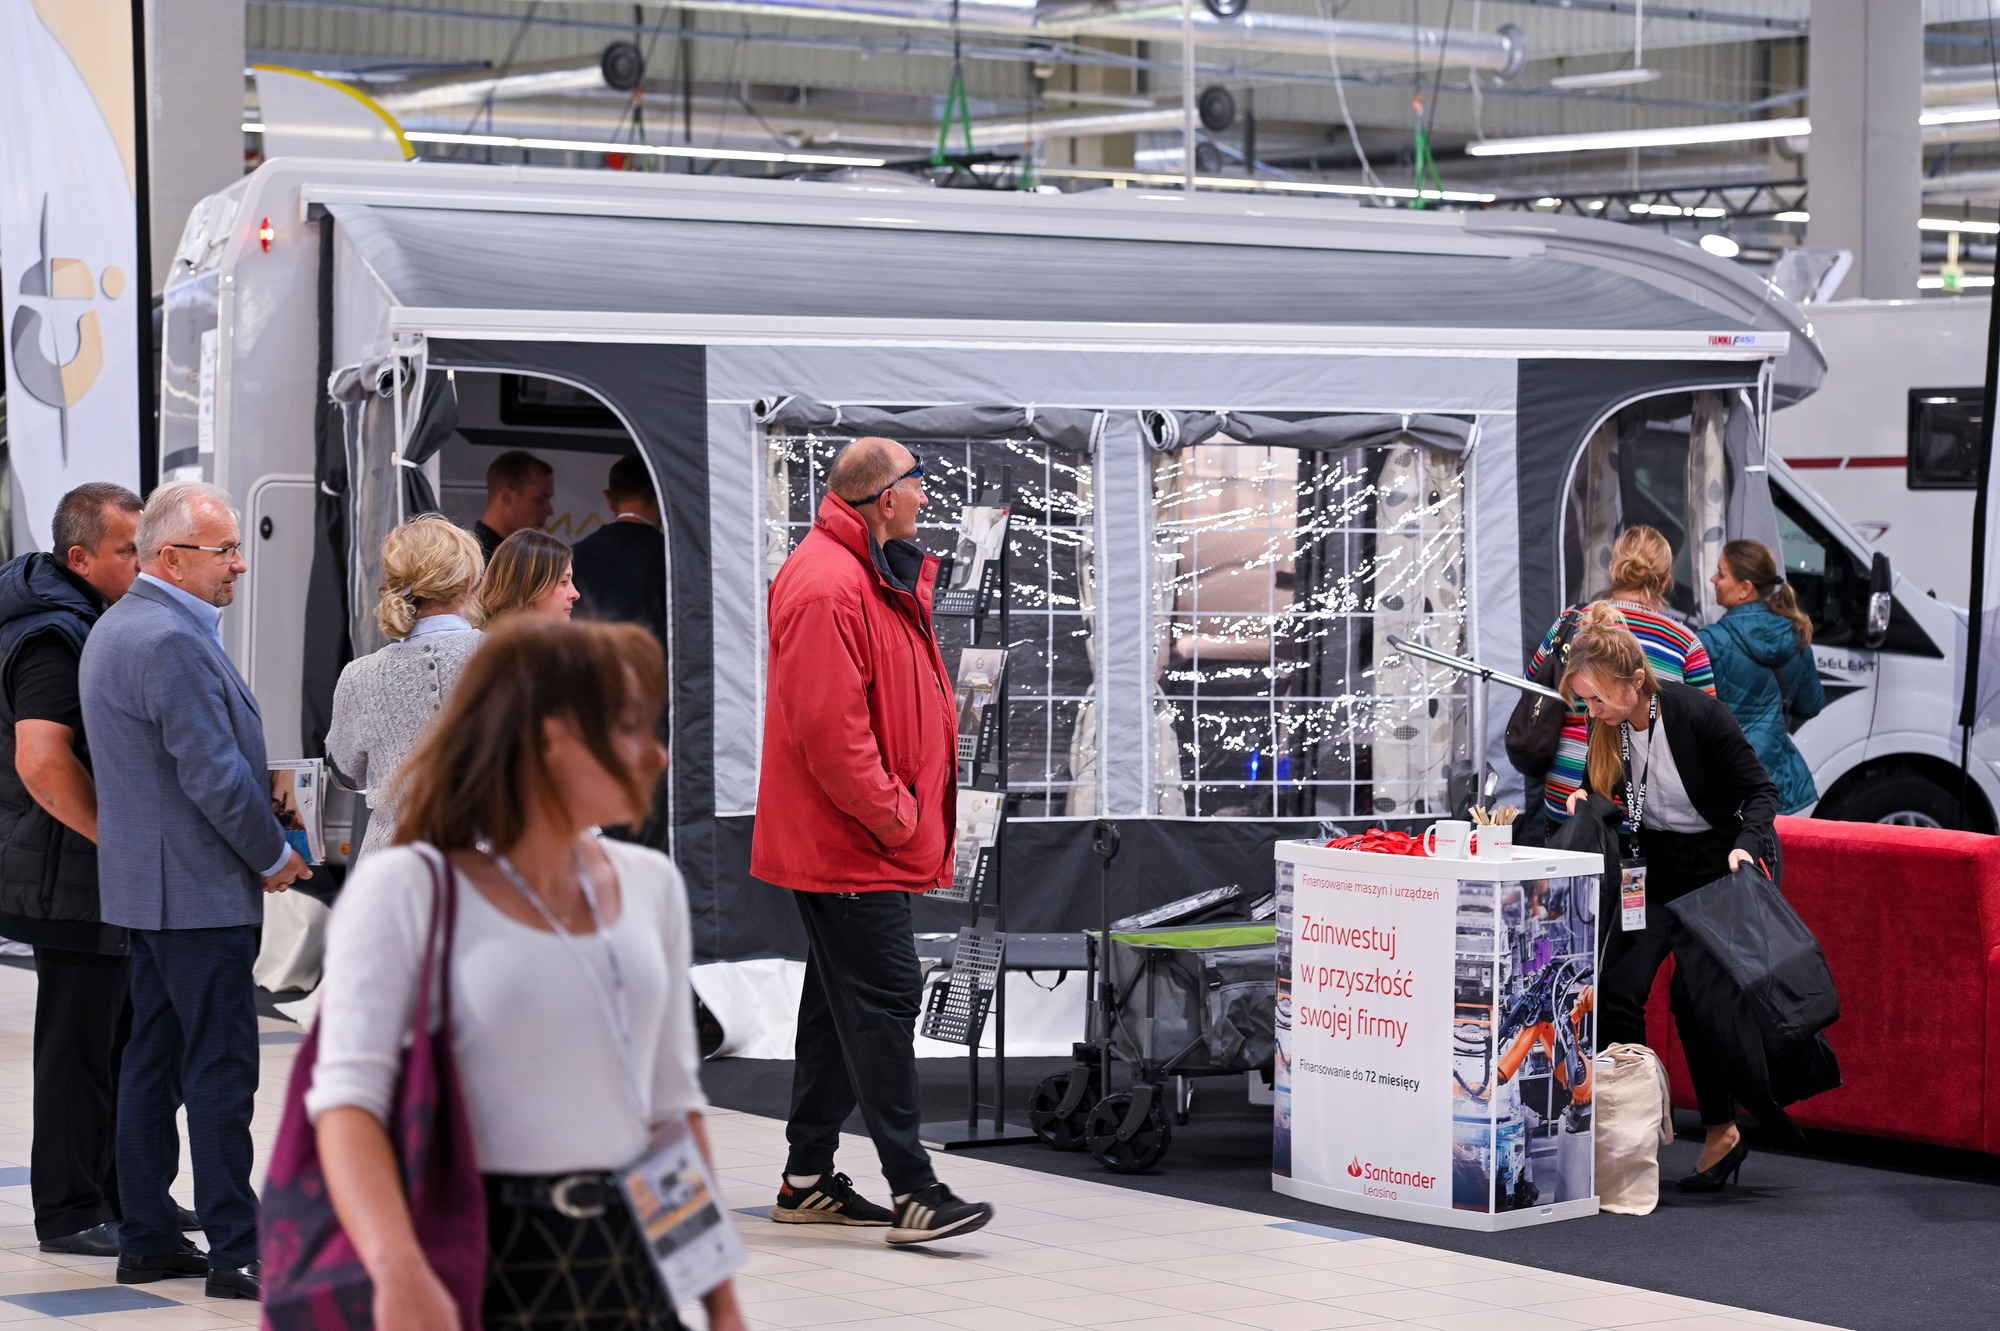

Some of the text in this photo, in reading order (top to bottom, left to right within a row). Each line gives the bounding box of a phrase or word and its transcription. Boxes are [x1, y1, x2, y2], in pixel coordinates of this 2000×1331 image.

[1817, 658, 1878, 673] SELEKT
[1649, 693, 1658, 719] METIC
[1620, 722, 1631, 761] DOMETIC
[1634, 783, 1646, 821] DOMETIC
[1302, 873, 1353, 892] Finansowanie
[1354, 882, 1388, 898] maszyn
[1395, 886, 1440, 902] urządzeń
[1301, 915, 1396, 960] Zainwestuj
[1300, 963, 1413, 998] w przyszłość
[1300, 1004, 1408, 1047] swojej firmy
[1299, 1058, 1420, 1092] Finansowanie do 72 miesięcy
[1363, 1183, 1397, 1200] Leasing
[1364, 1162, 1436, 1189] Santander
